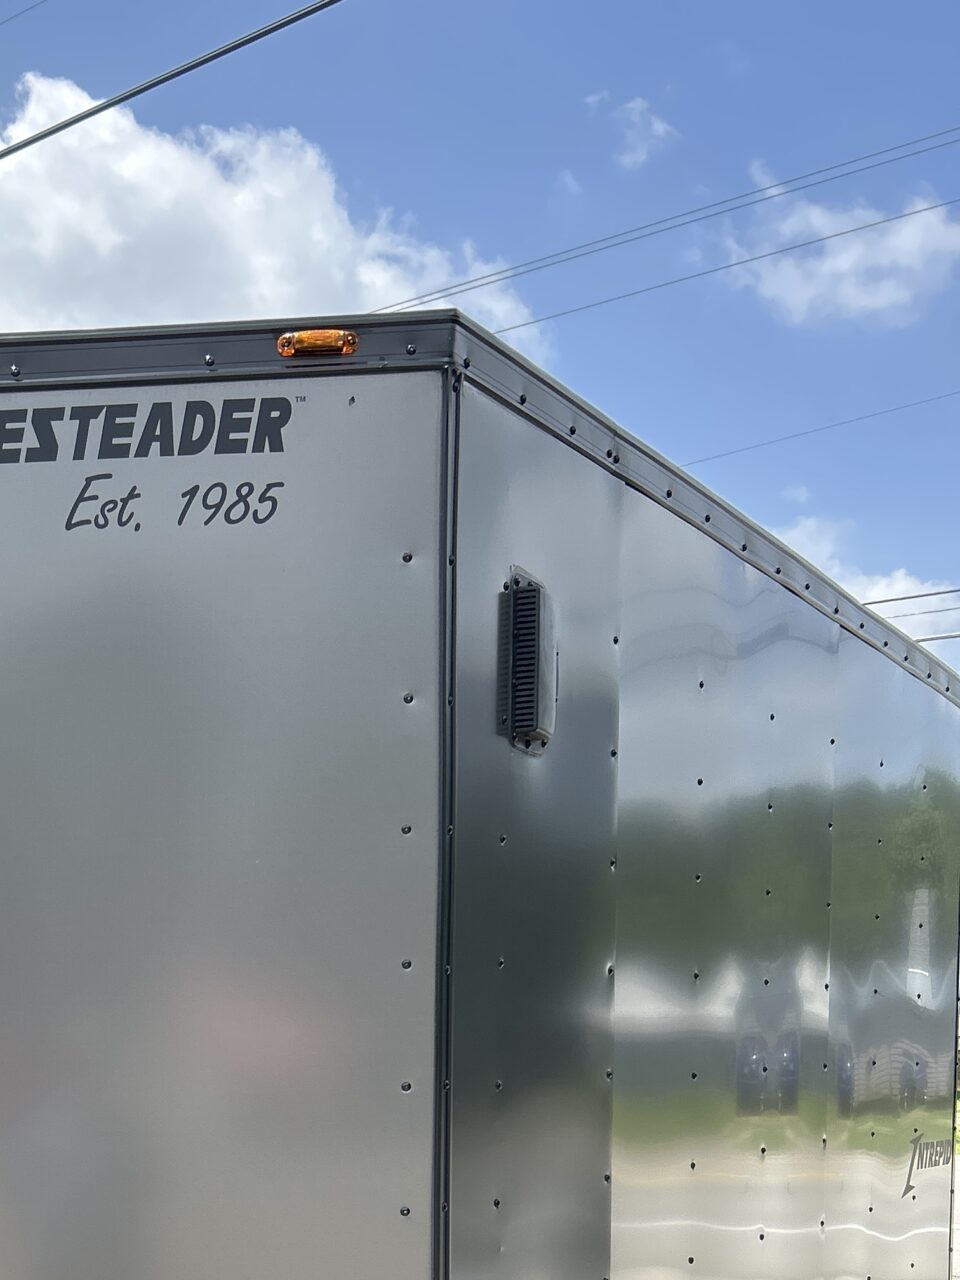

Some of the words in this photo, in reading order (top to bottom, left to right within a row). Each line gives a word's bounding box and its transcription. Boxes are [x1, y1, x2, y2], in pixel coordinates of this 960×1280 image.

[65, 472, 142, 532] Est.
[177, 480, 285, 527] 1985
[901, 1132, 952, 1199] INTREPID
